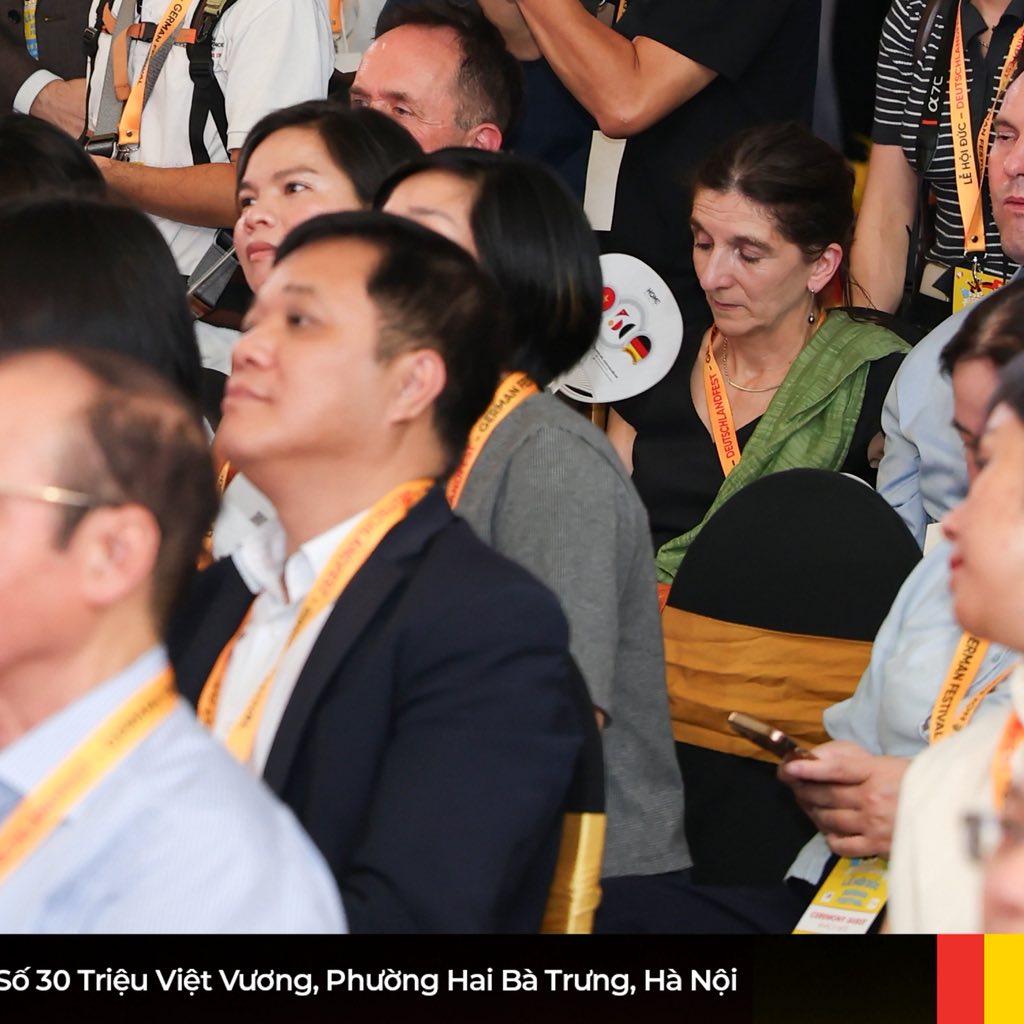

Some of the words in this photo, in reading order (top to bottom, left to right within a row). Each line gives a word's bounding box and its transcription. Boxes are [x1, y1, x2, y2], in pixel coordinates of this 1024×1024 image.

[155, 3, 182, 43] GERMAN
[958, 122, 969, 148] ĐỨC
[961, 153, 971, 171] HỘI
[478, 385, 520, 432] GERMAN
[710, 374, 734, 460] DEUTSCHLANDFEST
[953, 637, 980, 682] ERMAN
[933, 683, 960, 739] FESTIVAL
